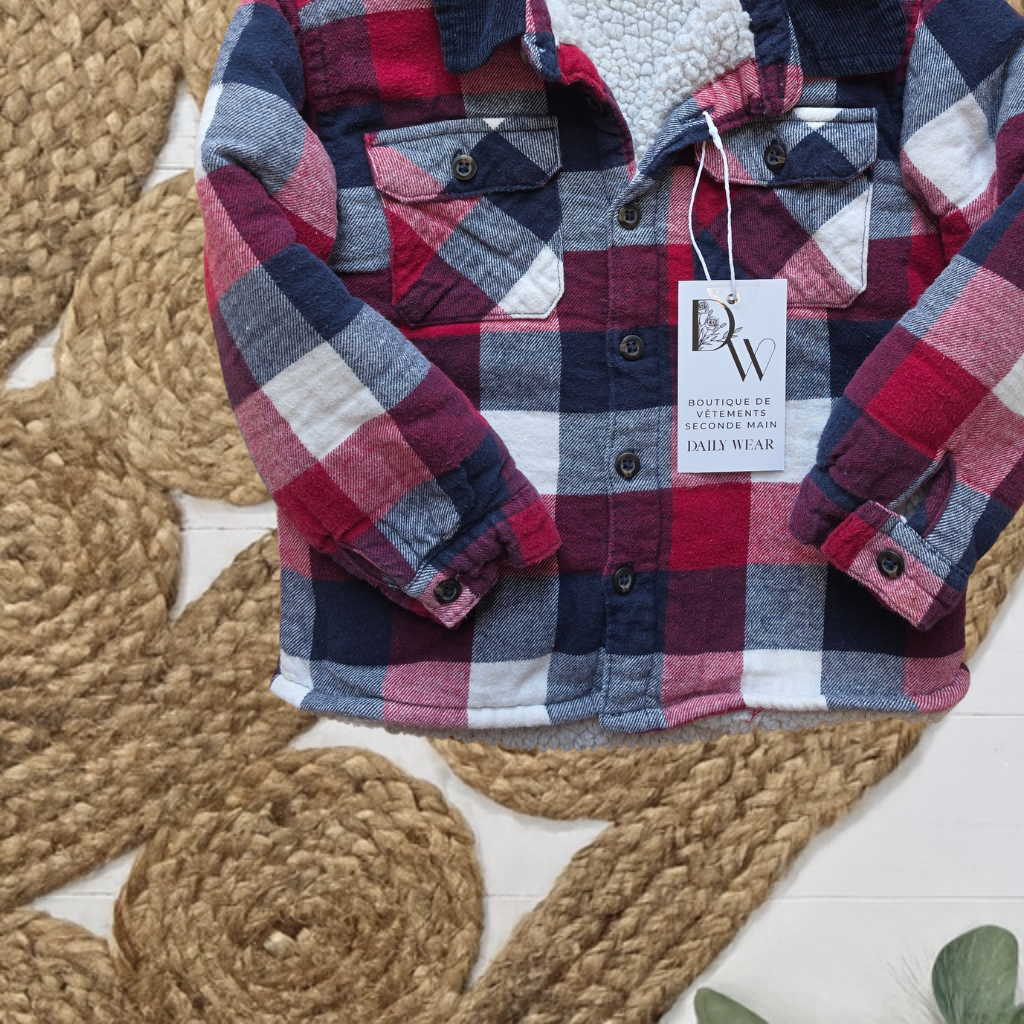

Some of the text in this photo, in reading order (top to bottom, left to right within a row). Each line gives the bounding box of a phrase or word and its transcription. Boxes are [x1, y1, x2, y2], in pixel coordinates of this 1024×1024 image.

[688, 397, 771, 407] BOUTIQUE DE
[696, 409, 766, 418] VÊTEMENTS
[685, 421, 777, 430] SECONDE MAIN
[687, 438, 774, 452] DAILY WEAR
